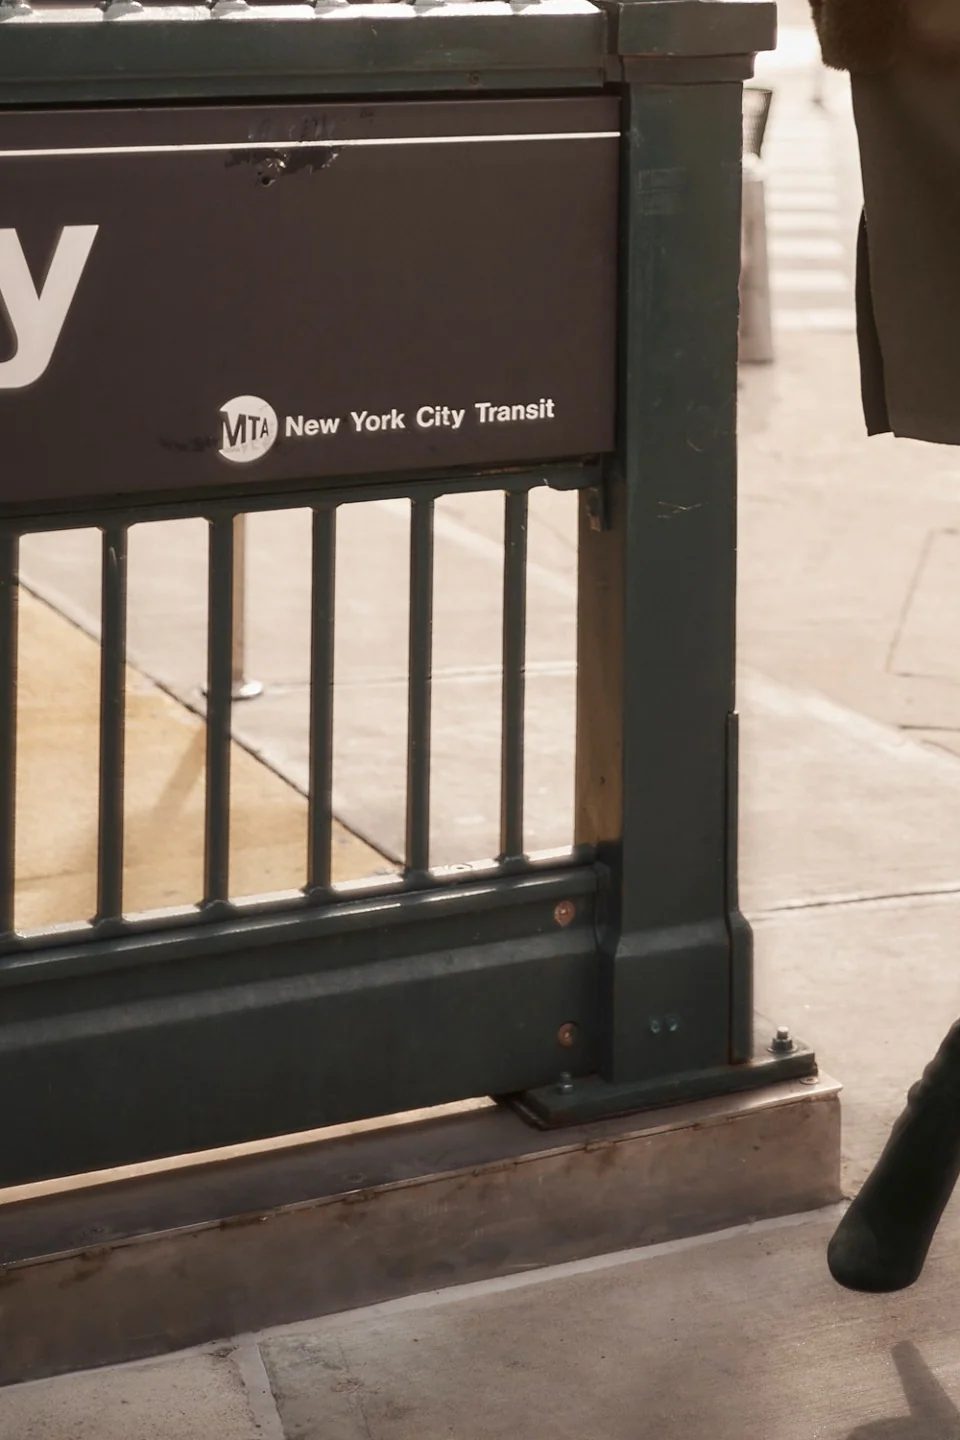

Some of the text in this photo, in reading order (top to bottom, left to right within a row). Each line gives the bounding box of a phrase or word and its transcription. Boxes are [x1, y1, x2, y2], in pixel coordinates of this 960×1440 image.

[220, 410, 269, 450] MTA
[285, 398, 555, 437] New York City Transit
